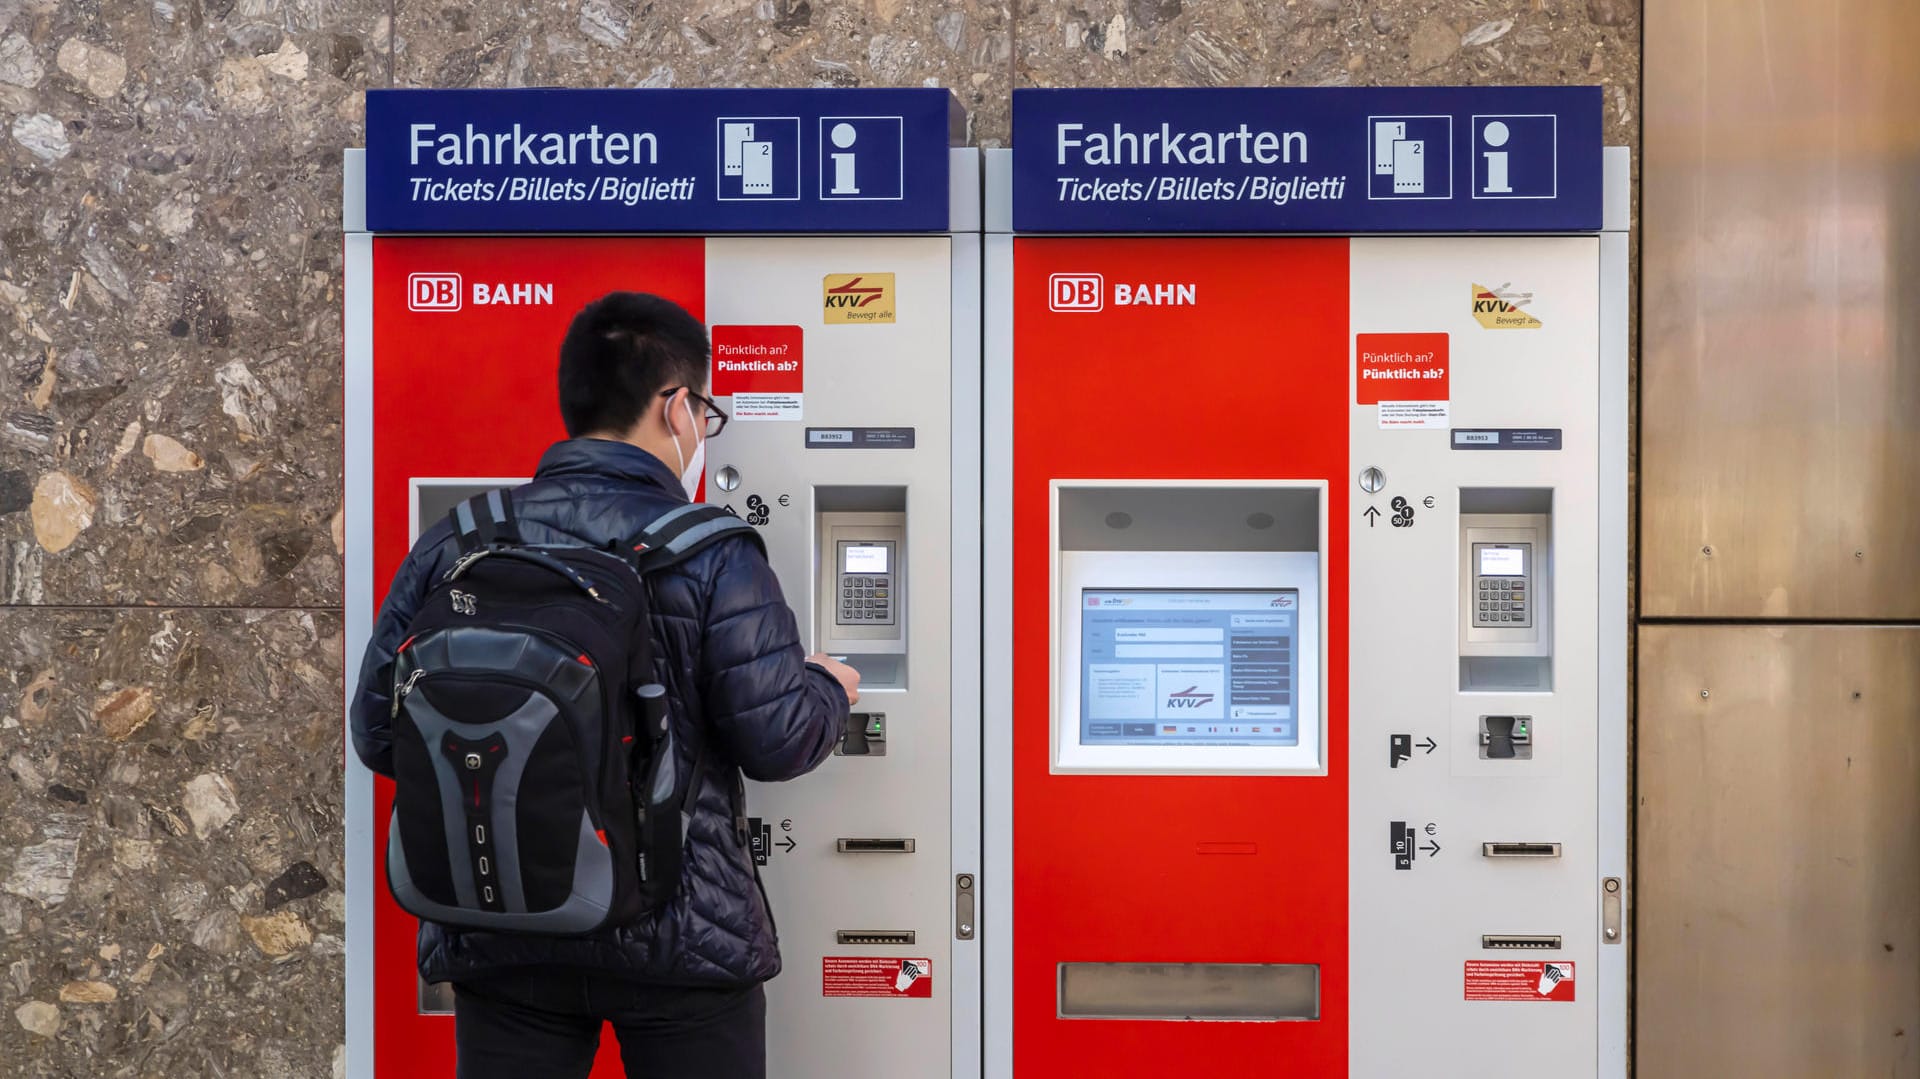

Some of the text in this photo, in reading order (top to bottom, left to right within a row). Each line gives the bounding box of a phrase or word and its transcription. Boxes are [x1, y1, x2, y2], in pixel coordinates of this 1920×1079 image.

[745, 126, 751, 137] 1
[1397, 125, 1402, 136] 1
[410, 123, 658, 165] Fahrkarten
[1057, 122, 1308, 165] Fahrkarten
[1413, 143, 1421, 154] 2
[761, 144, 769, 156] 2
[416, 280, 553, 305] DB BAHN
[1057, 280, 1196, 305] DB BAHN
[825, 295, 861, 308] KVV
[1473, 300, 1509, 313] KVV
[847, 311, 877, 320] Bewegt
[1496, 316, 1526, 326] Bewegt
[718, 344, 788, 355] Pünktlich an?
[1363, 352, 1434, 363] Pünktlich an?
[718, 361, 798, 371] Pünktlich ab?
[1363, 368, 1444, 379] Pünktlich ab?
[751, 498, 757, 507] 2
[778, 494, 790, 507] €
[1395, 500, 1402, 509] 2
[1423, 495, 1435, 508] €
[1167, 698, 1196, 708] KVV
[781, 818, 792, 831] €
[1425, 822, 1437, 835] €
[752, 837, 761, 846] 10
[1396, 841, 1405, 851] 10
